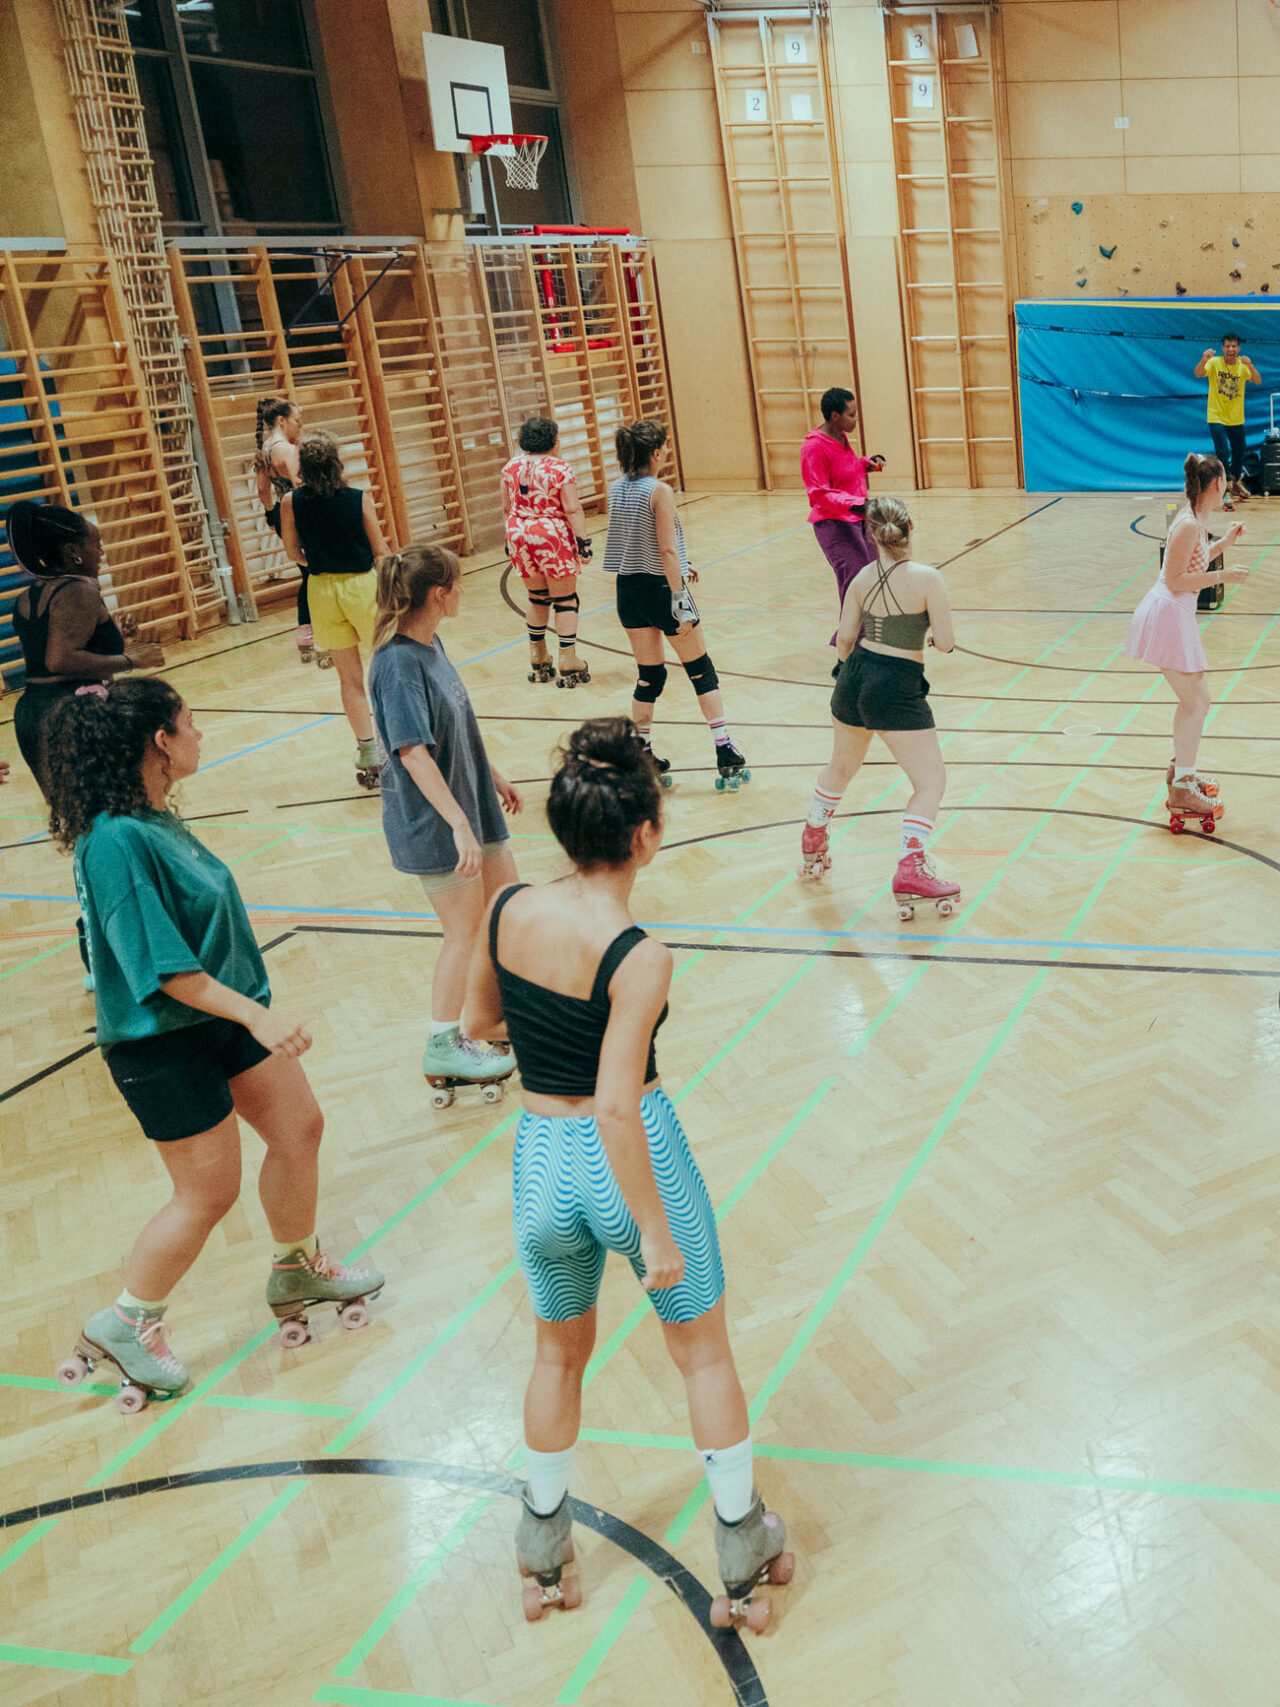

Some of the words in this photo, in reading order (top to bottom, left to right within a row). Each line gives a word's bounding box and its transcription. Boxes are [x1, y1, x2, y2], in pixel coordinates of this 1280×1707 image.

[914, 34, 923, 47] 3
[791, 42, 801, 55] 9
[918, 83, 928, 97] 9
[752, 97, 761, 111] 2
